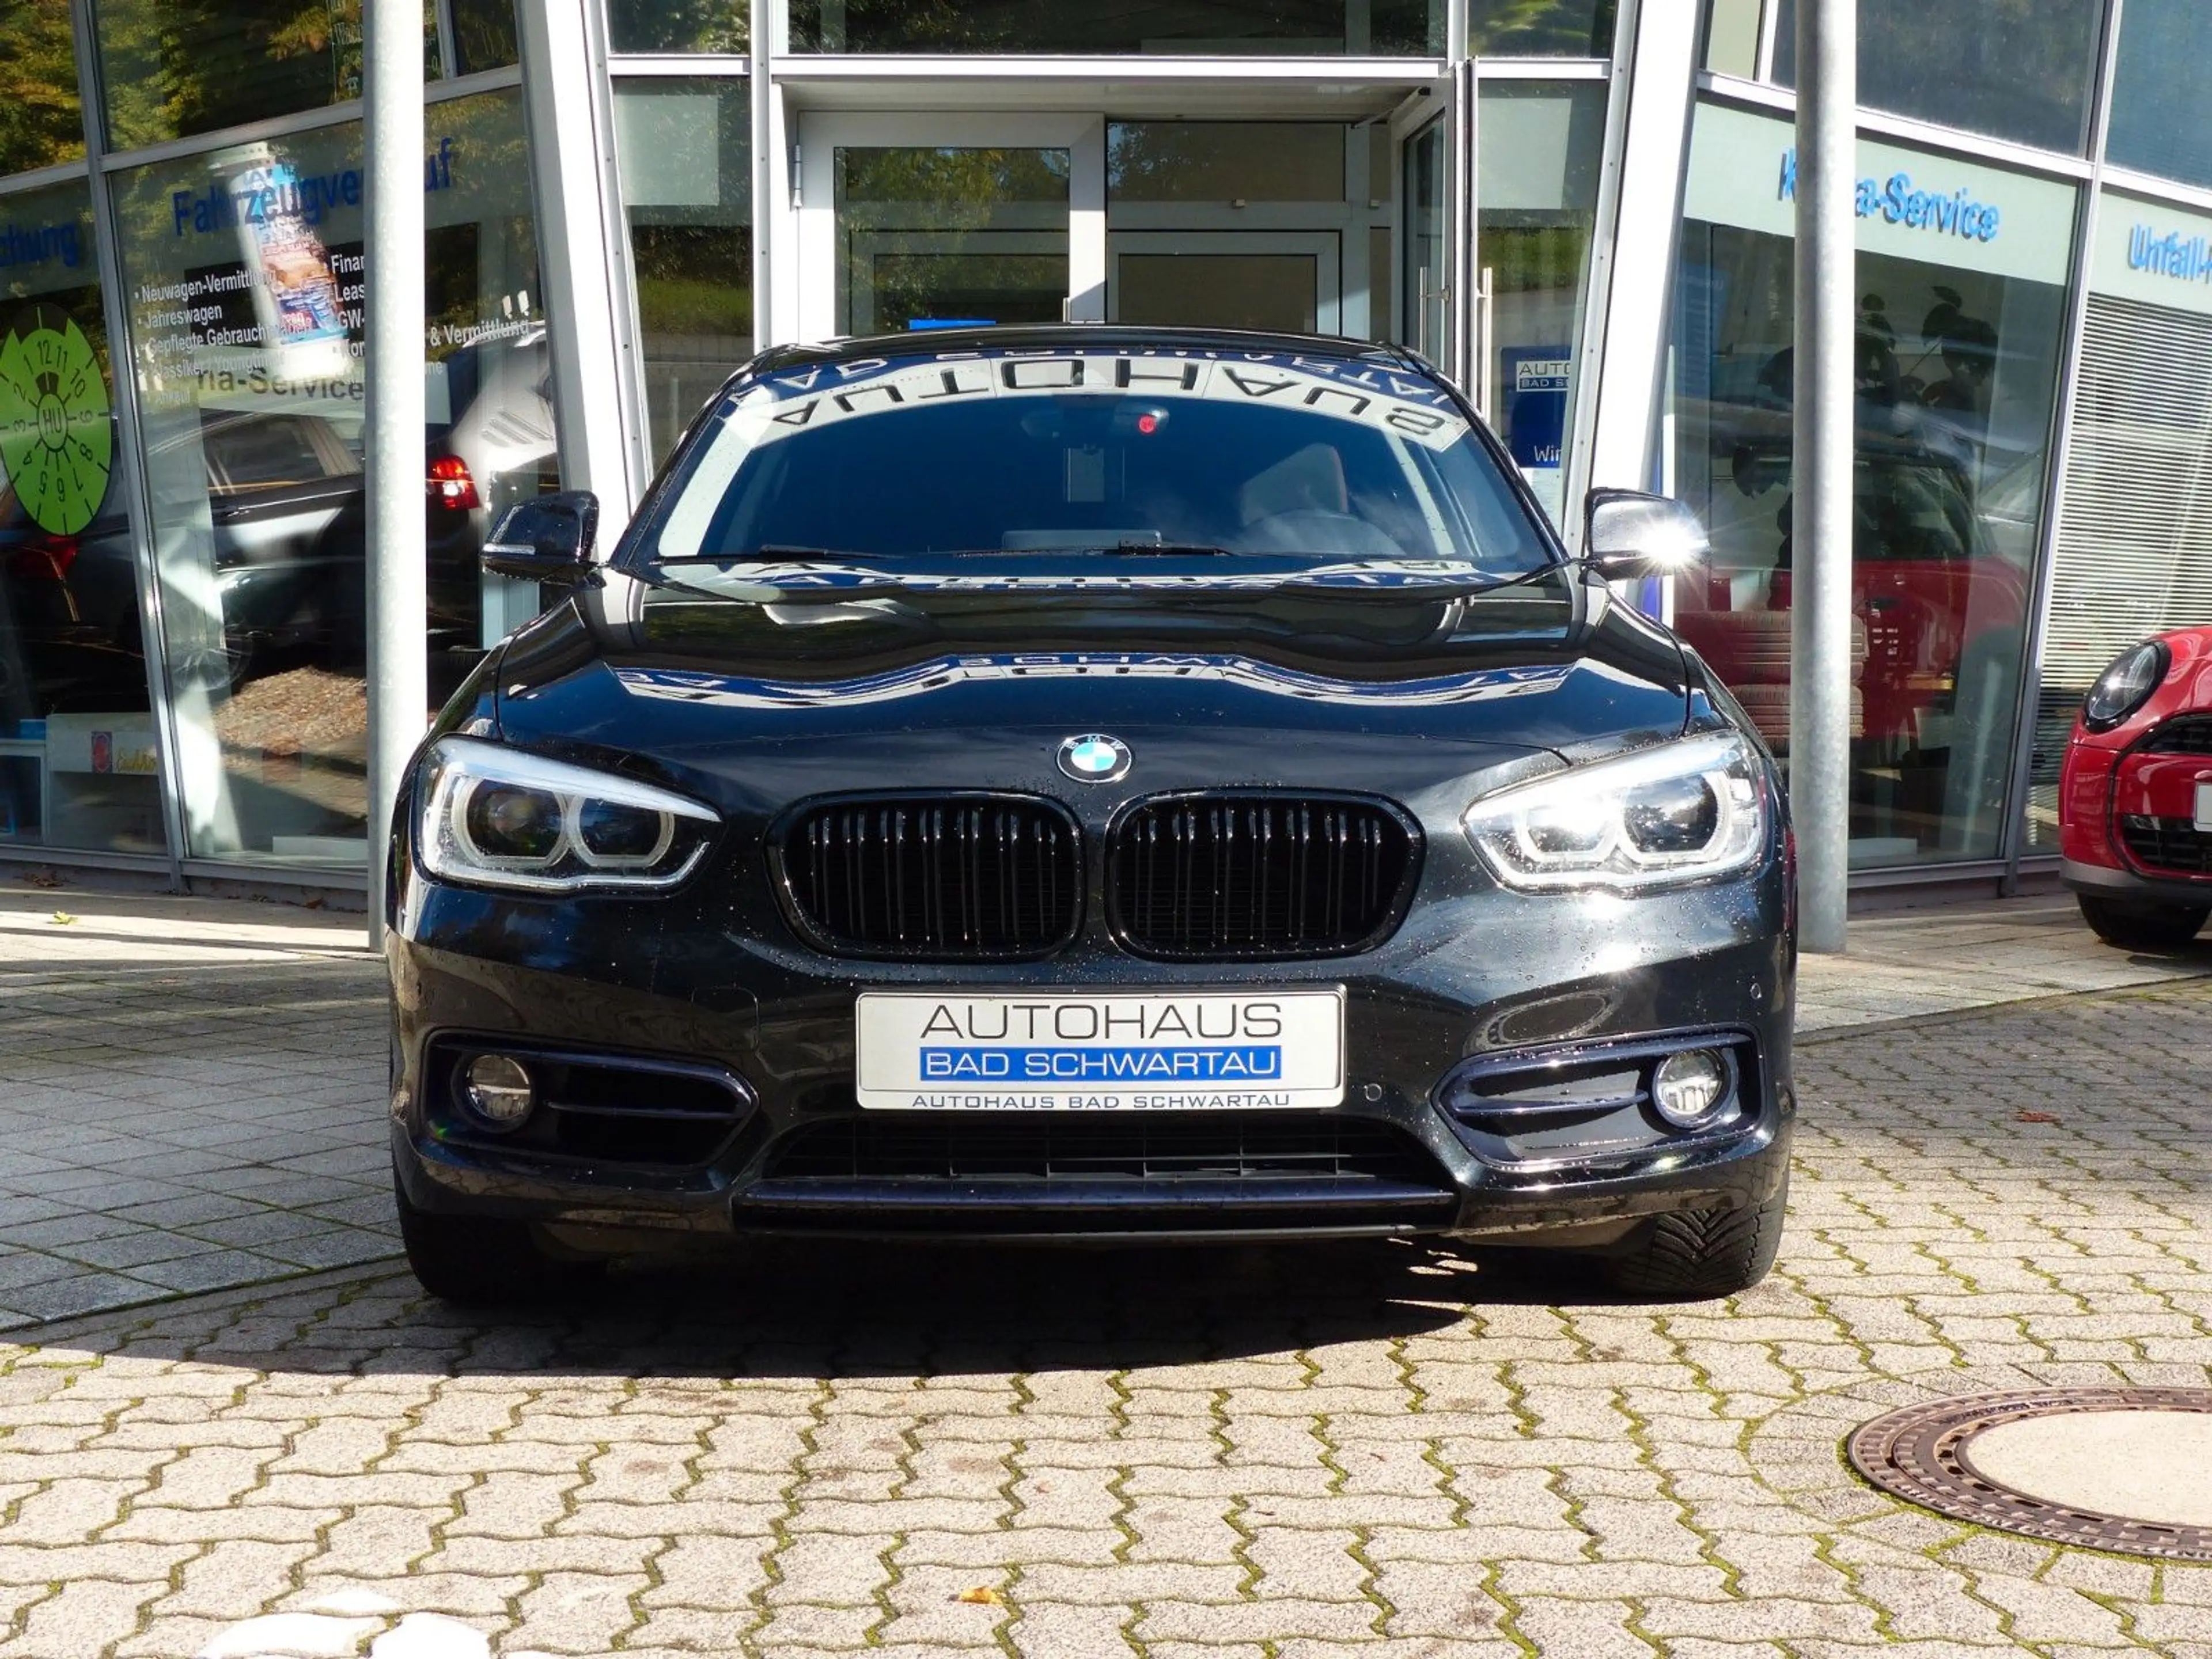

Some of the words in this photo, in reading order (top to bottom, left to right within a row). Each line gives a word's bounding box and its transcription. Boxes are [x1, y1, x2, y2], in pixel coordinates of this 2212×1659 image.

[2130, 224, 2212, 283] Unfall-
[145, 304, 222, 329] Jahreswagen
[430, 326, 441, 346] &
[444, 317, 529, 344] Vermittlung
[37, 339, 52, 365] 12
[1521, 378, 1549, 388] BAD
[42, 407, 62, 434] HU
[921, 1003, 1282, 1039] AUTOHAUS
[926, 1052, 1009, 1075] BAD
[1025, 1051, 1275, 1075] SCHWARTAU
[912, 1094, 1056, 1109] AUTOHAUS
[1068, 1096, 1120, 1109] BAD
[1132, 1093, 1291, 1109] SCHWARTAU
